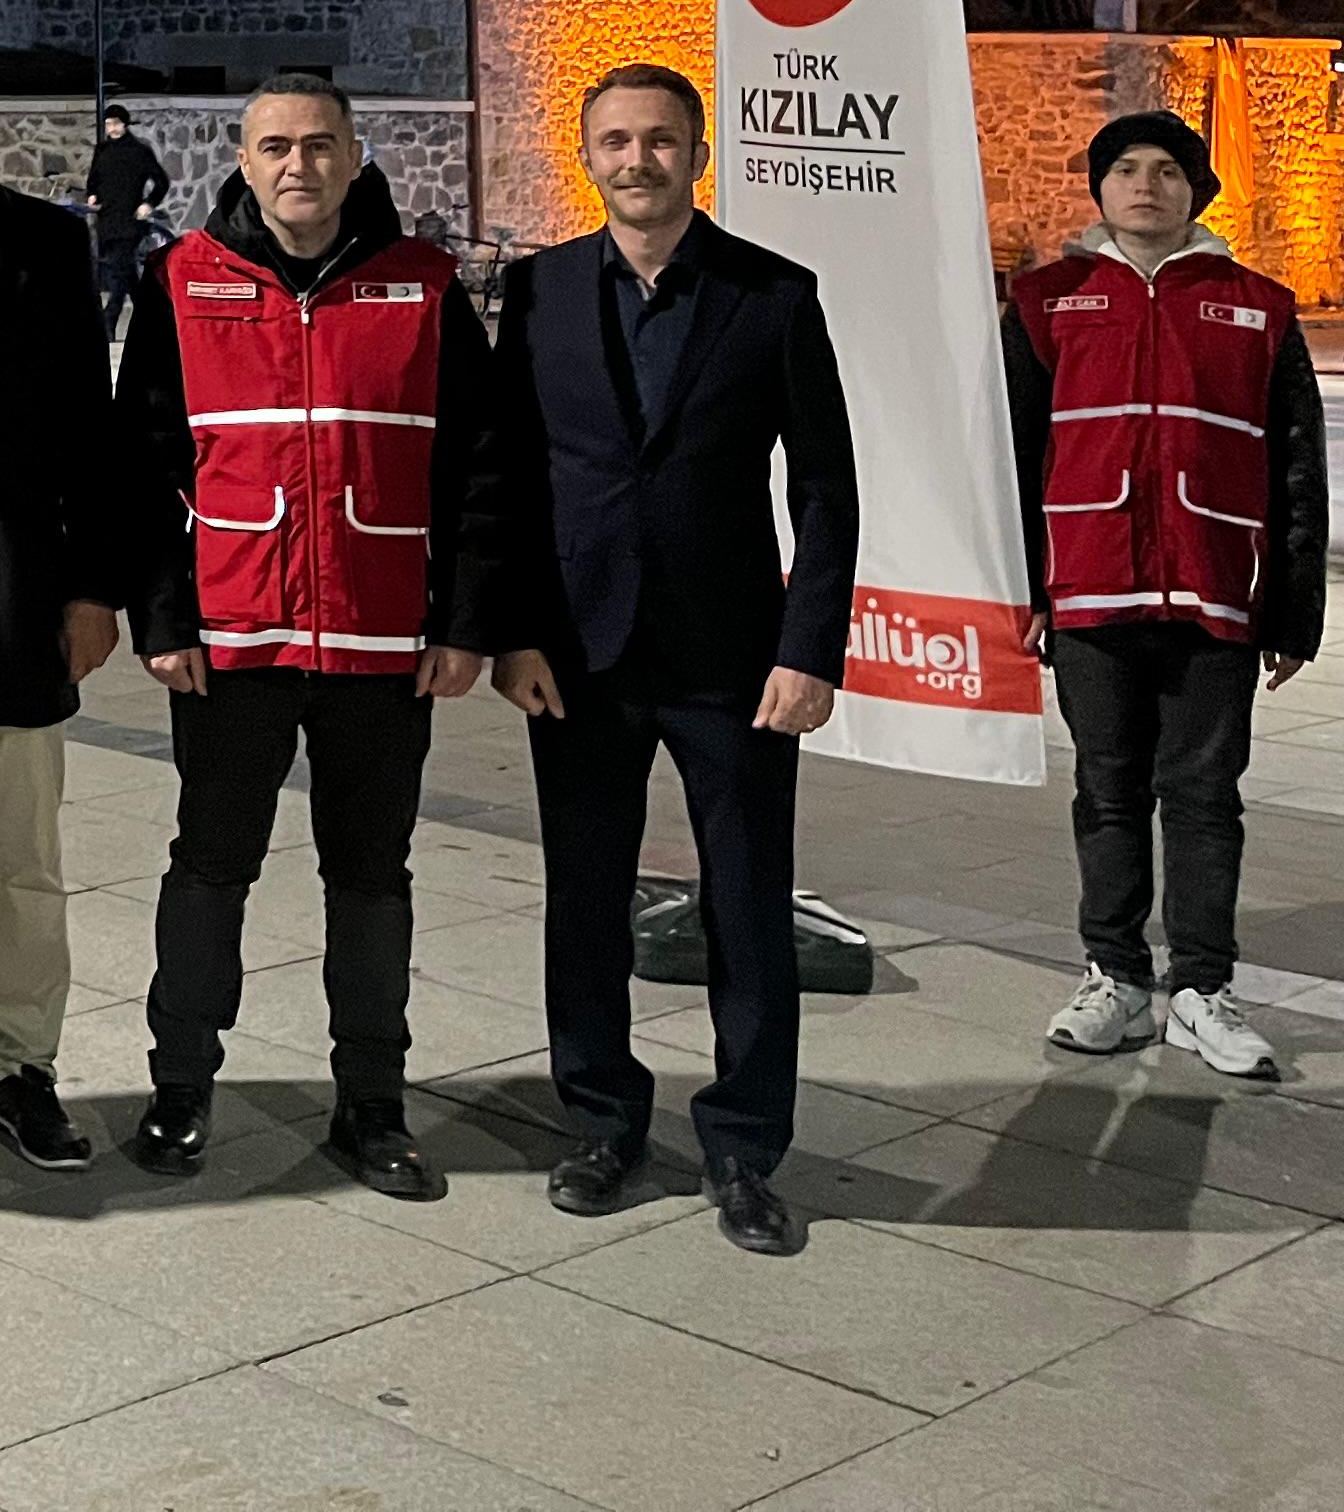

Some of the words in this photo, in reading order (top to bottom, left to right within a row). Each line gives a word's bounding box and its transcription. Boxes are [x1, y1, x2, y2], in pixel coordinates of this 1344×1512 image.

[773, 47, 840, 81] TÜRK
[741, 86, 900, 140] KIZILAY
[745, 156, 898, 195] SEYDİŞEHİR
[915, 671, 982, 699] .org
